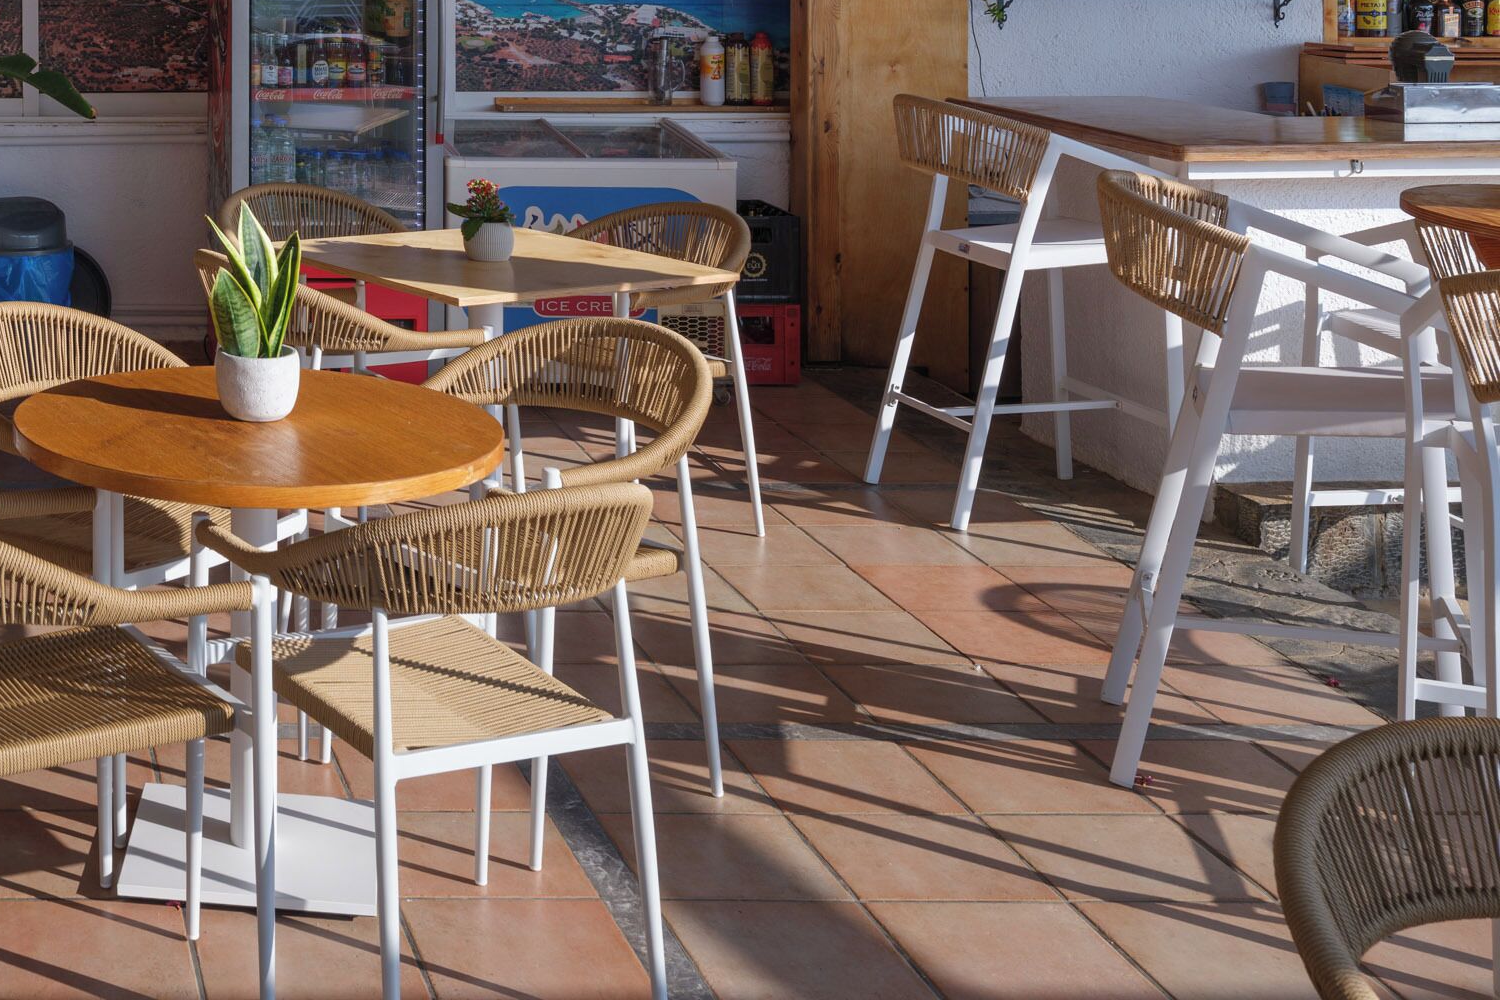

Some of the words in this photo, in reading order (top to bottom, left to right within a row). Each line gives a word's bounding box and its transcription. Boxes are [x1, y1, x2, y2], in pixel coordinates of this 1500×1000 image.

[255, 90, 285, 101] Coca-Cola
[313, 89, 343, 100] Coca-Cola
[372, 88, 404, 99] Coca-Cola
[541, 301, 570, 312] ICE
[576, 301, 613, 312] CRE
